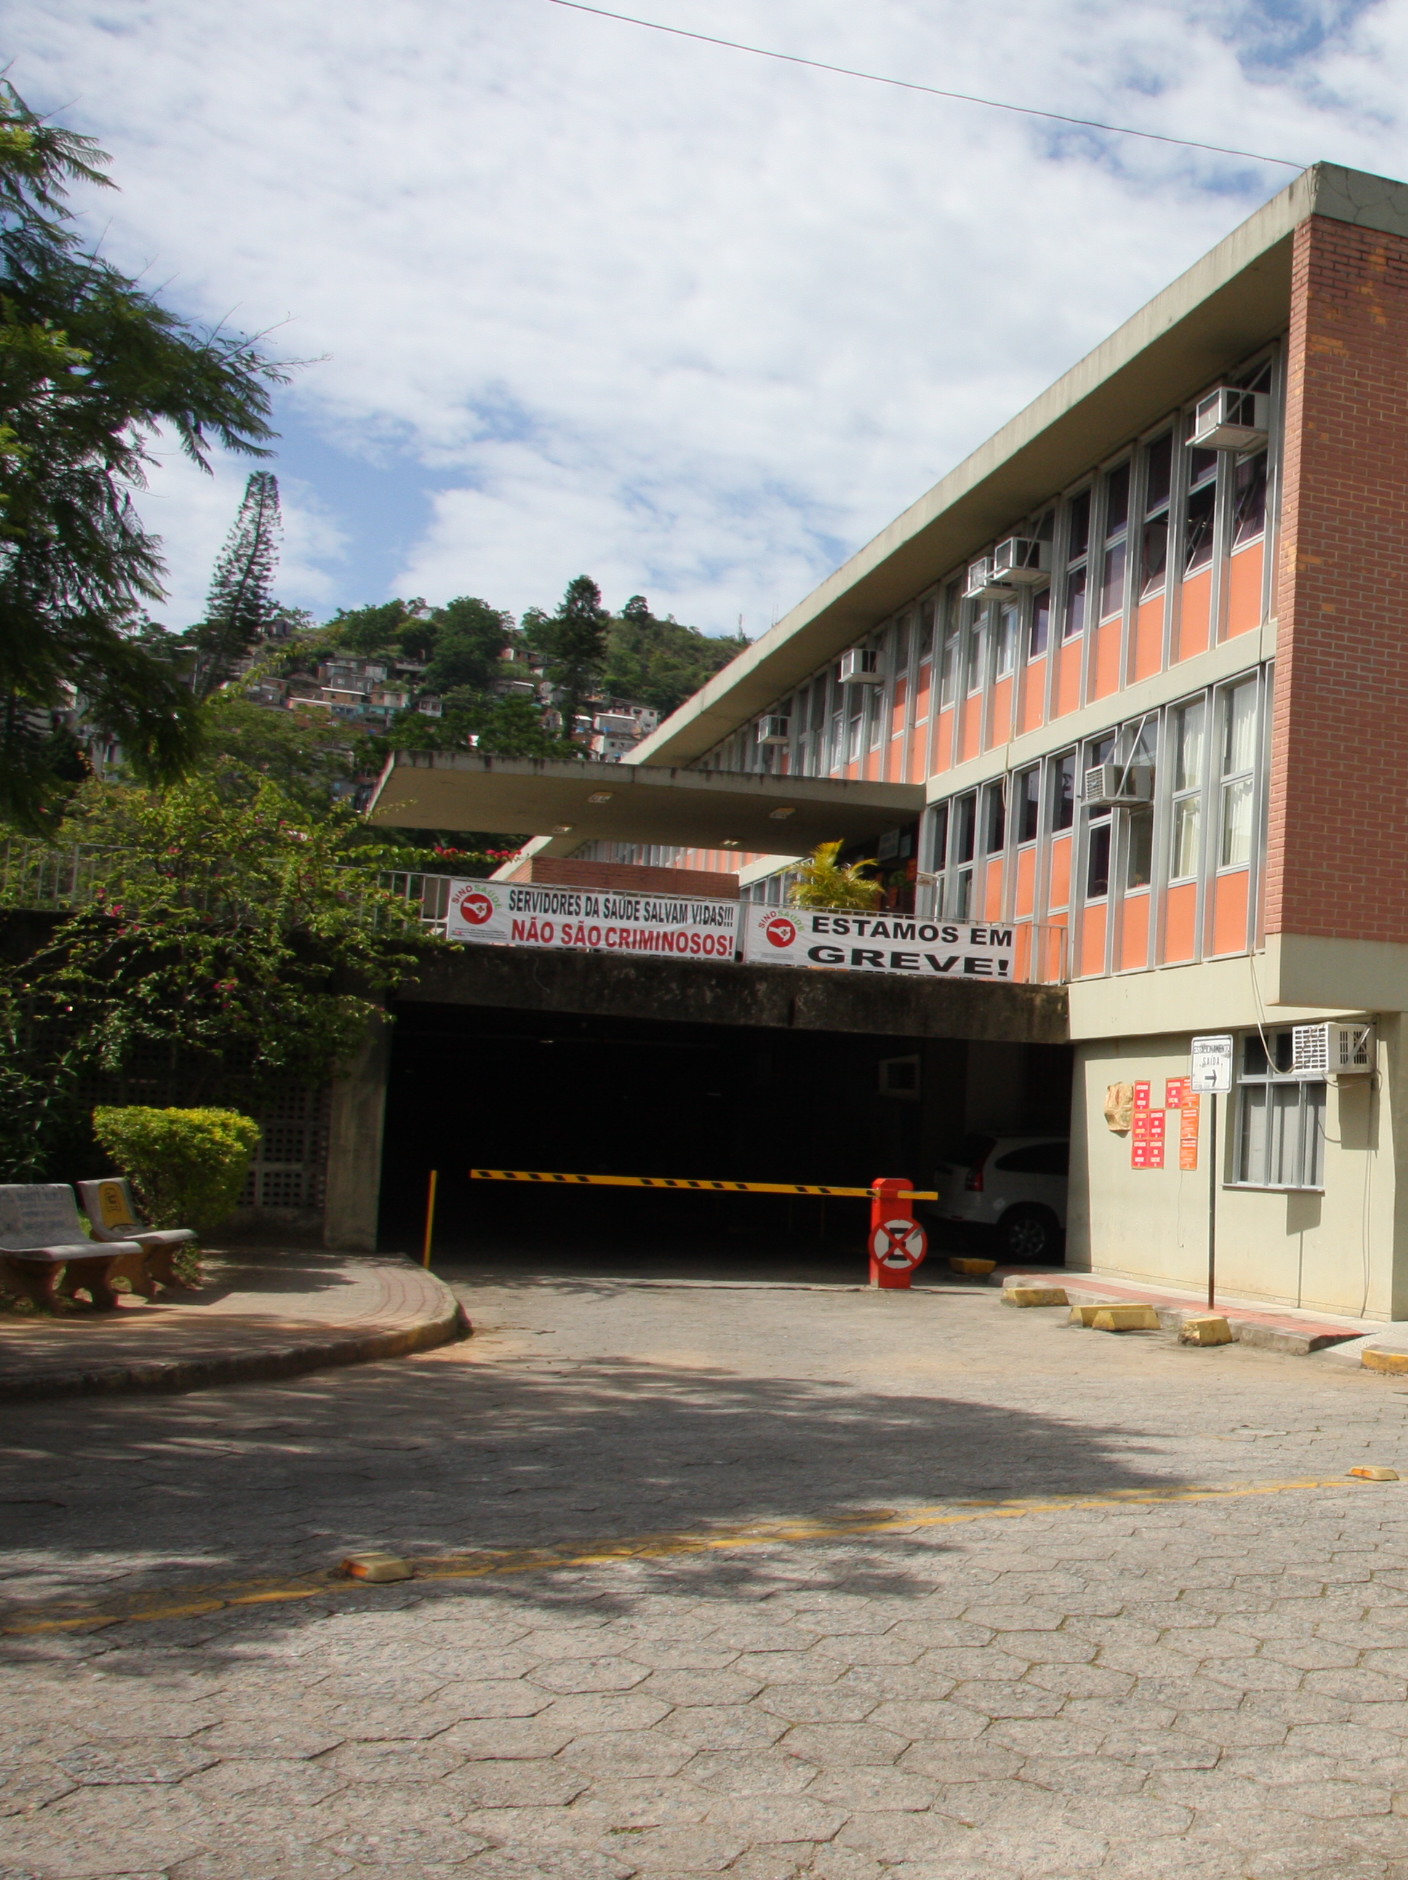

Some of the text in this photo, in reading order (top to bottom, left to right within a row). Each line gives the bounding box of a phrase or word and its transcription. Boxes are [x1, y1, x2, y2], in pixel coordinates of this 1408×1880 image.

[508, 889, 581, 916] SERVIDORES
[585, 895, 600, 919] DA
[644, 900, 688, 924] SALVAM
[691, 904, 734, 927] VIDAS!!!
[511, 916, 555, 944] NÃO
[561, 919, 602, 947] SÃO
[605, 926, 734, 957] CRIMINOSOS!
[812, 915, 1012, 947] ESTAMOS EM
[807, 945, 1009, 977] GREVE!
